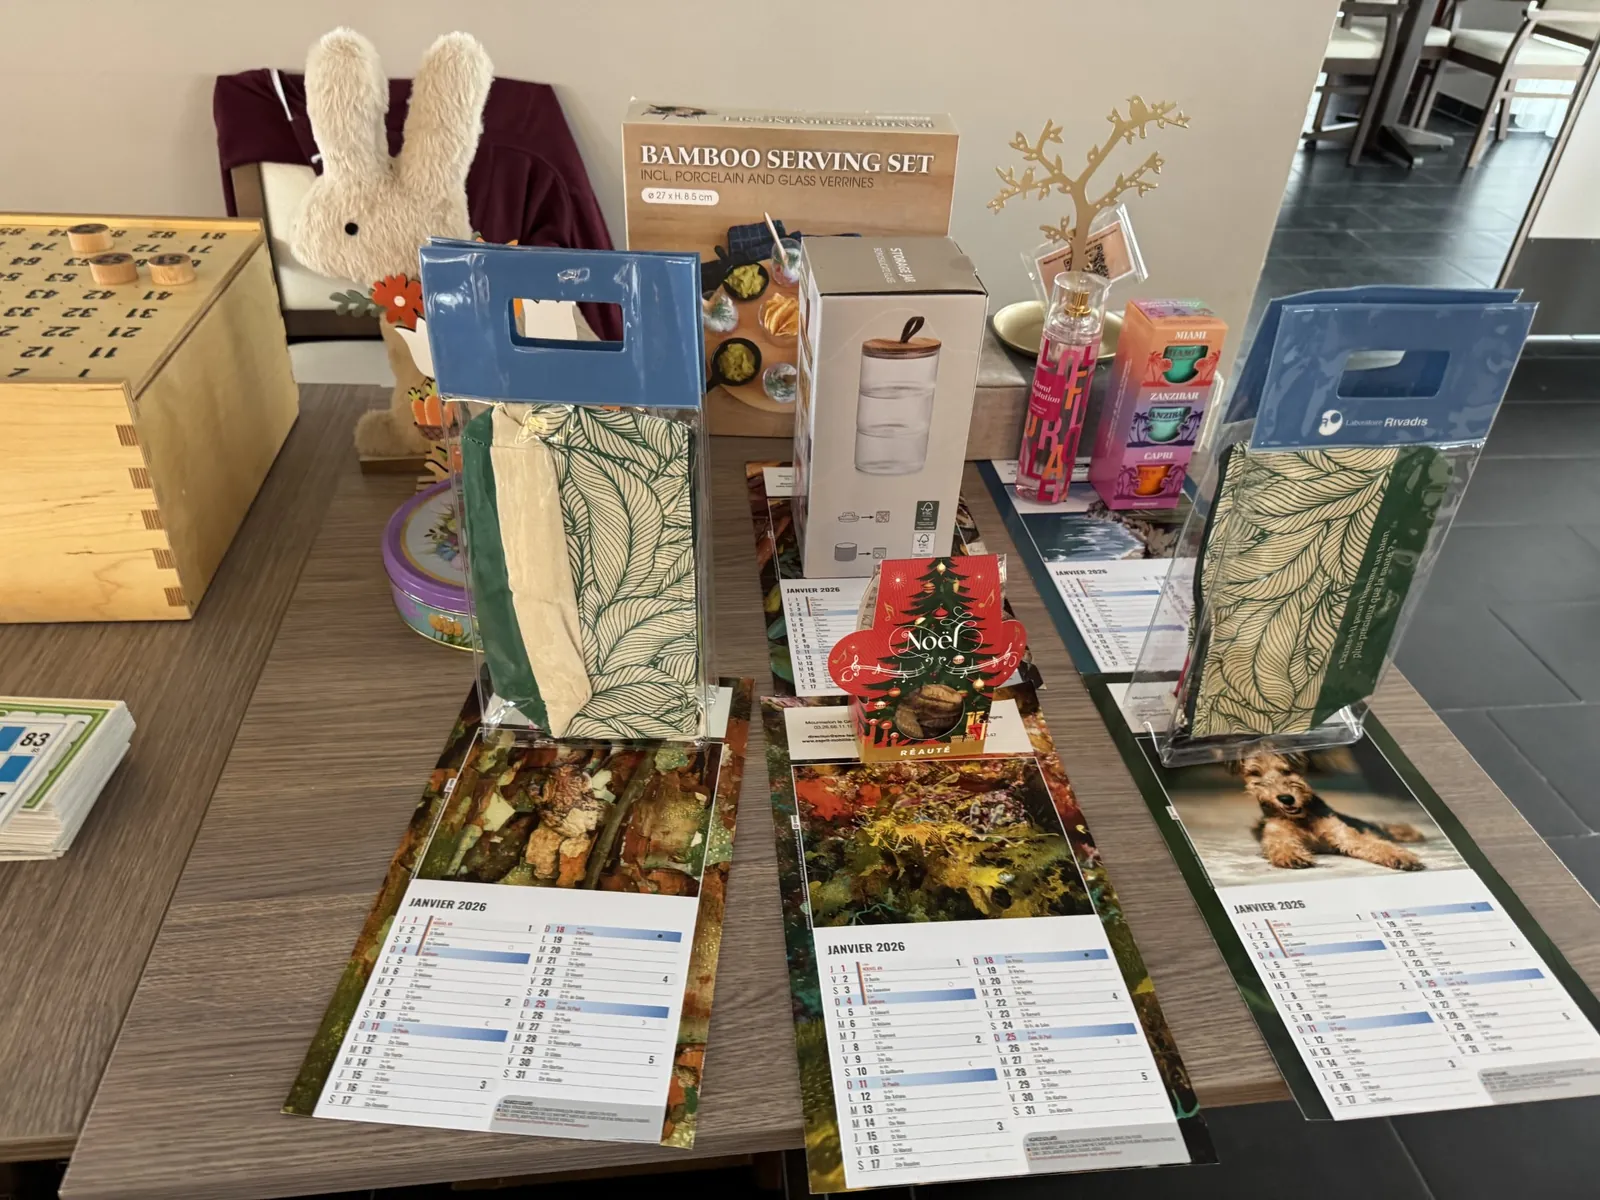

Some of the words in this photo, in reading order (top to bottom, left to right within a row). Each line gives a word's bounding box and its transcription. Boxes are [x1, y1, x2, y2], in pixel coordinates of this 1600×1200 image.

[640, 144, 761, 168] BAMBOO
[767, 149, 881, 173] SERVING
[887, 153, 934, 174] SET
[640, 169, 672, 183] INCL.
[675, 170, 745, 184] PORCELAIN
[747, 173, 775, 185] AND
[778, 174, 816, 187] GLASS
[820, 176, 875, 189] VERRINES
[656, 191, 666, 200] 27
[698, 193, 713, 202] cm
[148, 230, 177, 239] 82
[201, 232, 227, 240] 81
[28, 242, 58, 251] 74
[132, 244, 161, 253] 72
[187, 245, 213, 253] 71
[9, 256, 42, 266] 64
[890, 247, 912, 273] STORAGE
[44, 272, 78, 283] 53
[25, 289, 60, 299] 43
[82, 289, 117, 300] 42
[142, 290, 173, 300] 41
[3, 306, 40, 317] 33
[61, 307, 98, 318] 32
[125, 308, 158, 318] 31
[41, 325, 80, 338] 22
[107, 326, 142, 338] 21
[1175, 331, 1207, 340] MIAMI
[20, 346, 54, 358] 12
[88, 347, 118, 358] 11
[1150, 392, 1200, 400] ZANZIBAR
[1384, 416, 1428, 428] Rivadis
[1144, 452, 1173, 460] CAPRI
[1377, 530, 1390, 552] bien
[1374, 553, 1383, 566] un
[1374, 577, 1384, 586] la
[1370, 588, 1382, 604] que
[901, 621, 964, 651] Noël
[1352, 641, 1364, 659] plus
[20, 732, 51, 747] 83
[900, 745, 951, 757] RÉAUTÉ
[409, 897, 455, 909] JANVIER
[457, 901, 487, 912] 2026
[1234, 902, 1276, 915] JANVIER
[1278, 900, 1306, 910] 2026
[550, 946, 561, 954] 20
[828, 943, 874, 956] JANVIER
[876, 941, 906, 953] 2026
[544, 967, 555, 975] 22
[541, 978, 552, 986] 23
[990, 977, 1000, 985] 20
[538, 989, 549, 997] 24
[993, 988, 1003, 996] 21
[380, 999, 387, 1008] 9
[535, 1000, 546, 1008] 25
[846, 997, 852, 1005] 4
[996, 999, 1007, 1007] 22
[375, 1011, 386, 1019] 10
[532, 1011, 544, 1019] 26
[848, 1008, 854, 1016] 5
[999, 1010, 1010, 1018] 23
[371, 1022, 380, 1031] 11
[529, 1023, 540, 1031] 27
[850, 1019, 856, 1028] 6
[1002, 1021, 1013, 1030] 24
[366, 1034, 377, 1042] 12
[525, 1034, 537, 1043] 28
[851, 1031, 856, 1039] 7
[1005, 1033, 1017, 1041] 25
[362, 1046, 372, 1055] 13
[522, 1046, 534, 1055] 29
[853, 1043, 859, 1051] 8
[1008, 1044, 1020, 1053] 26
[357, 1058, 367, 1066] 14
[519, 1058, 531, 1067] 30
[855, 1055, 861, 1063] 9
[1012, 1056, 1022, 1064] 27
[352, 1070, 362, 1079] 15
[515, 1070, 526, 1079] 31
[857, 1067, 867, 1076] 10
[1016, 1068, 1027, 1076] 28
[347, 1083, 358, 1092] 16
[858, 1080, 867, 1088] 11
[1018, 1080, 1030, 1089] 29
[341, 1096, 351, 1105] 17
[861, 1092, 871, 1100] 12
[1022, 1093, 1034, 1101] 30
[862, 1105, 873, 1114] 13
[1026, 1105, 1036, 1114] 31
[864, 1118, 875, 1127] 14
[867, 1131, 877, 1140] 15
[868, 1145, 879, 1154] 16
[870, 1159, 880, 1169] 17
